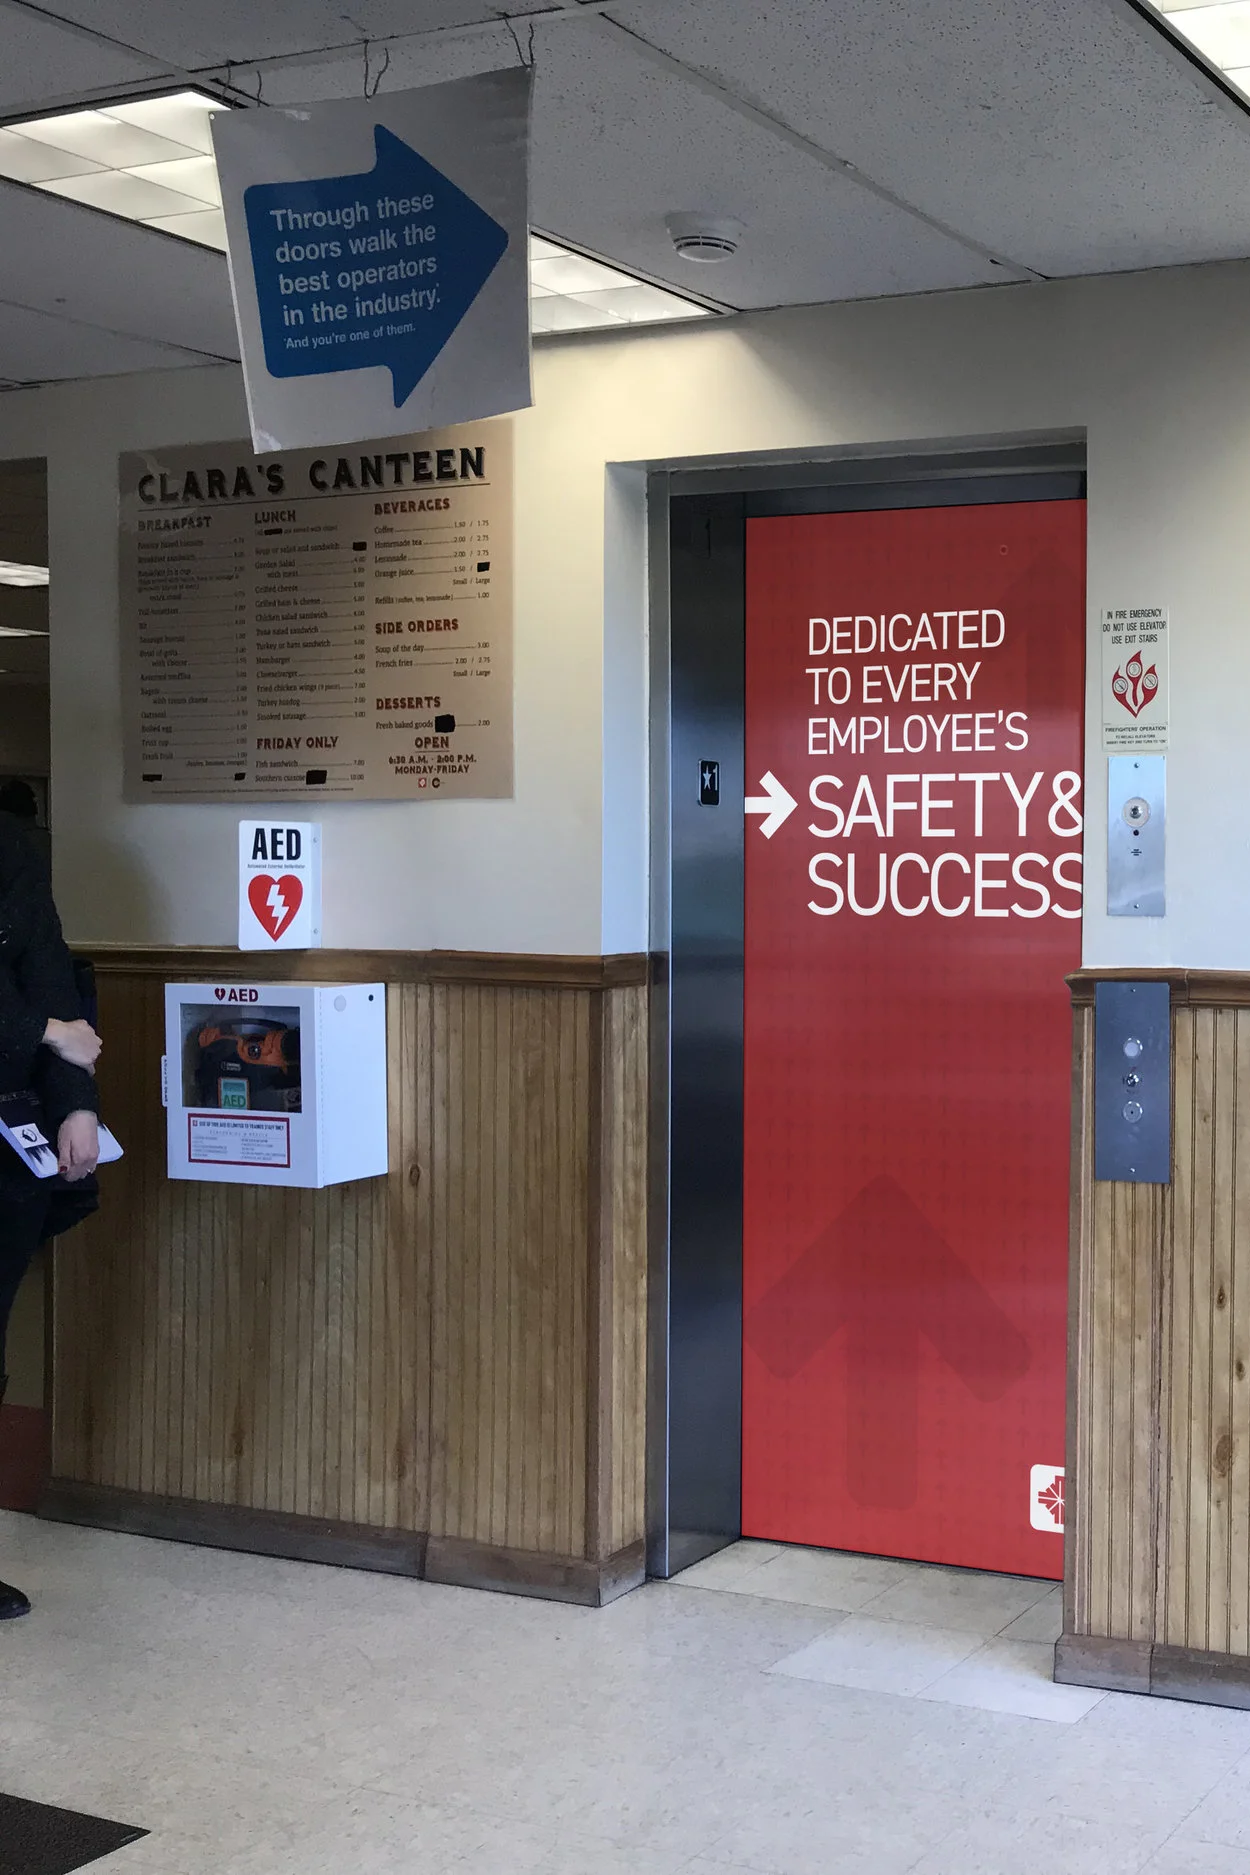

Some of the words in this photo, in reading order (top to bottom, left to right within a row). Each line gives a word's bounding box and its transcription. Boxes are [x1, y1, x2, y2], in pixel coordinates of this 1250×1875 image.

[269, 202, 369, 233] Through
[376, 193, 434, 220] these
[275, 239, 342, 265] doors
[349, 229, 397, 255] walk
[403, 224, 436, 247] the
[279, 271, 331, 296] best
[337, 256, 437, 293] operators
[283, 305, 305, 327] in
[312, 300, 348, 326] the
[312, 332, 346, 349] you're
[350, 330, 370, 342] one
[373, 326, 384, 338] of
[388, 322, 415, 337] them.
[138, 463, 287, 504] CLARA'S
[309, 446, 488, 494] CANTEEN
[374, 498, 450, 515] BEVERAGES
[138, 516, 212, 531] BREAKFAST
[255, 510, 296, 524] LUNCH
[375, 526, 394, 534] Coffee
[375, 540, 410, 549] Homemade
[375, 554, 407, 564] Lemonade
[375, 570, 397, 579] Orange
[398, 569, 414, 577] juice
[475, 577, 491, 585] Large
[255, 613, 280, 621] Chicken
[281, 612, 297, 620] salad
[299, 611, 328, 619] sandwich
[1107, 611, 1113, 619] IN
[1115, 610, 1127, 619] FIRE
[1130, 608, 1162, 618] EMERGENCY
[290, 625, 319, 633] sandwich
[375, 621, 403, 635] SIDE
[407, 618, 459, 633] ORDERS
[808, 609, 1006, 656] DEDICATED
[1103, 623, 1111, 632] DO
[1113, 622, 1124, 631] NOT
[1127, 622, 1137, 631] USE
[1140, 620, 1166, 630] ELEVATOR
[256, 642, 277, 650] Turkey
[302, 639, 331, 648] sandwich
[1111, 635, 1122, 644] USE
[1125, 635, 1136, 643] EXIT
[1139, 634, 1158, 643] STAIRS
[376, 645, 391, 654] Soup
[401, 644, 411, 652] the
[413, 643, 425, 653] day
[376, 659, 398, 668] French
[398, 658, 413, 666] fries
[475, 668, 491, 676] Large
[274, 683, 298, 691] chicken
[806, 667, 852, 705] TO
[863, 661, 982, 704] EVERY
[376, 696, 441, 711] DESSERTS
[376, 721, 393, 729] Fresh
[394, 720, 414, 729] baked
[415, 720, 433, 729] goods
[808, 710, 1030, 755] EMPLOYEE'S
[256, 737, 302, 750] FRIDAY
[305, 735, 339, 749] ONLY
[414, 736, 450, 749] OPEN
[270, 760, 299, 768] sandwich
[252, 828, 302, 861] AED
[807, 851, 1083, 919] SUCCESS
[228, 988, 258, 1003] AED
[223, 1094, 246, 1108] AED
